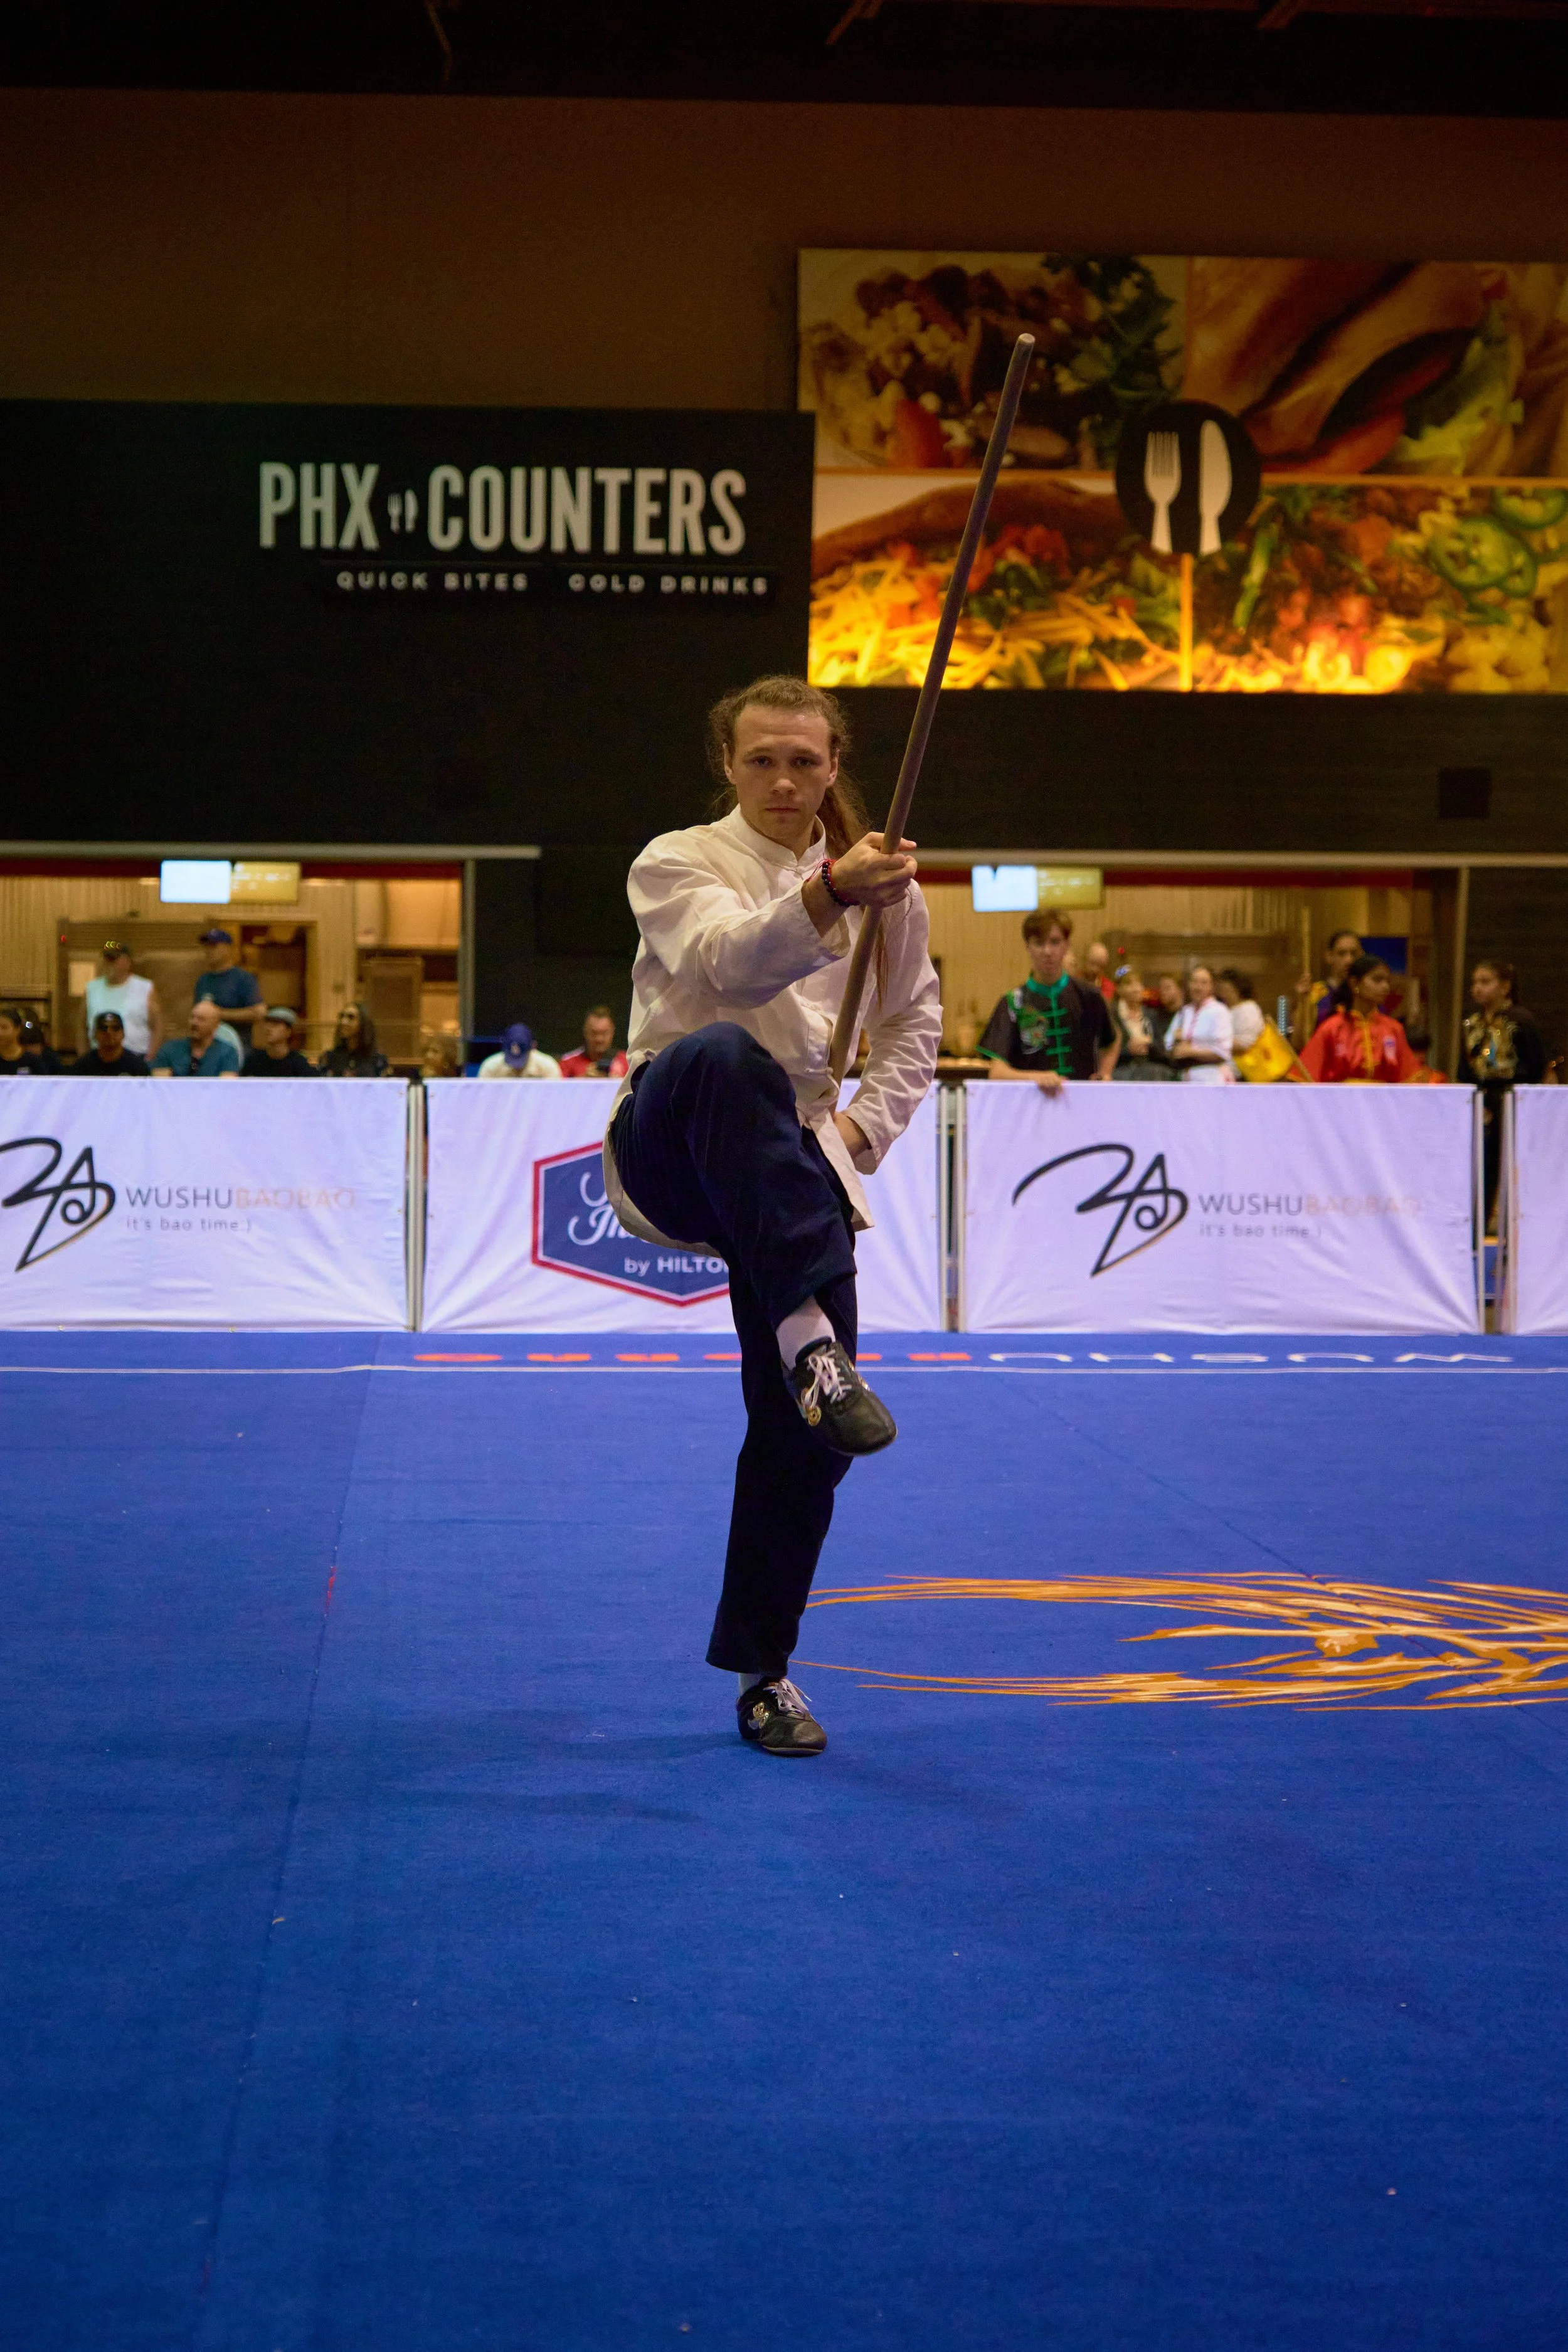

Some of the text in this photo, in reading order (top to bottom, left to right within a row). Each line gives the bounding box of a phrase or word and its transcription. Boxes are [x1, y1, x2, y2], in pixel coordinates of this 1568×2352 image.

[260, 462, 746, 556] PHX COUNTERS
[336, 571, 768, 595] QUICK BITES COLD DRINKS
[161, 1217, 192, 1231] bao
[624, 1256, 729, 1276] by HILTO
